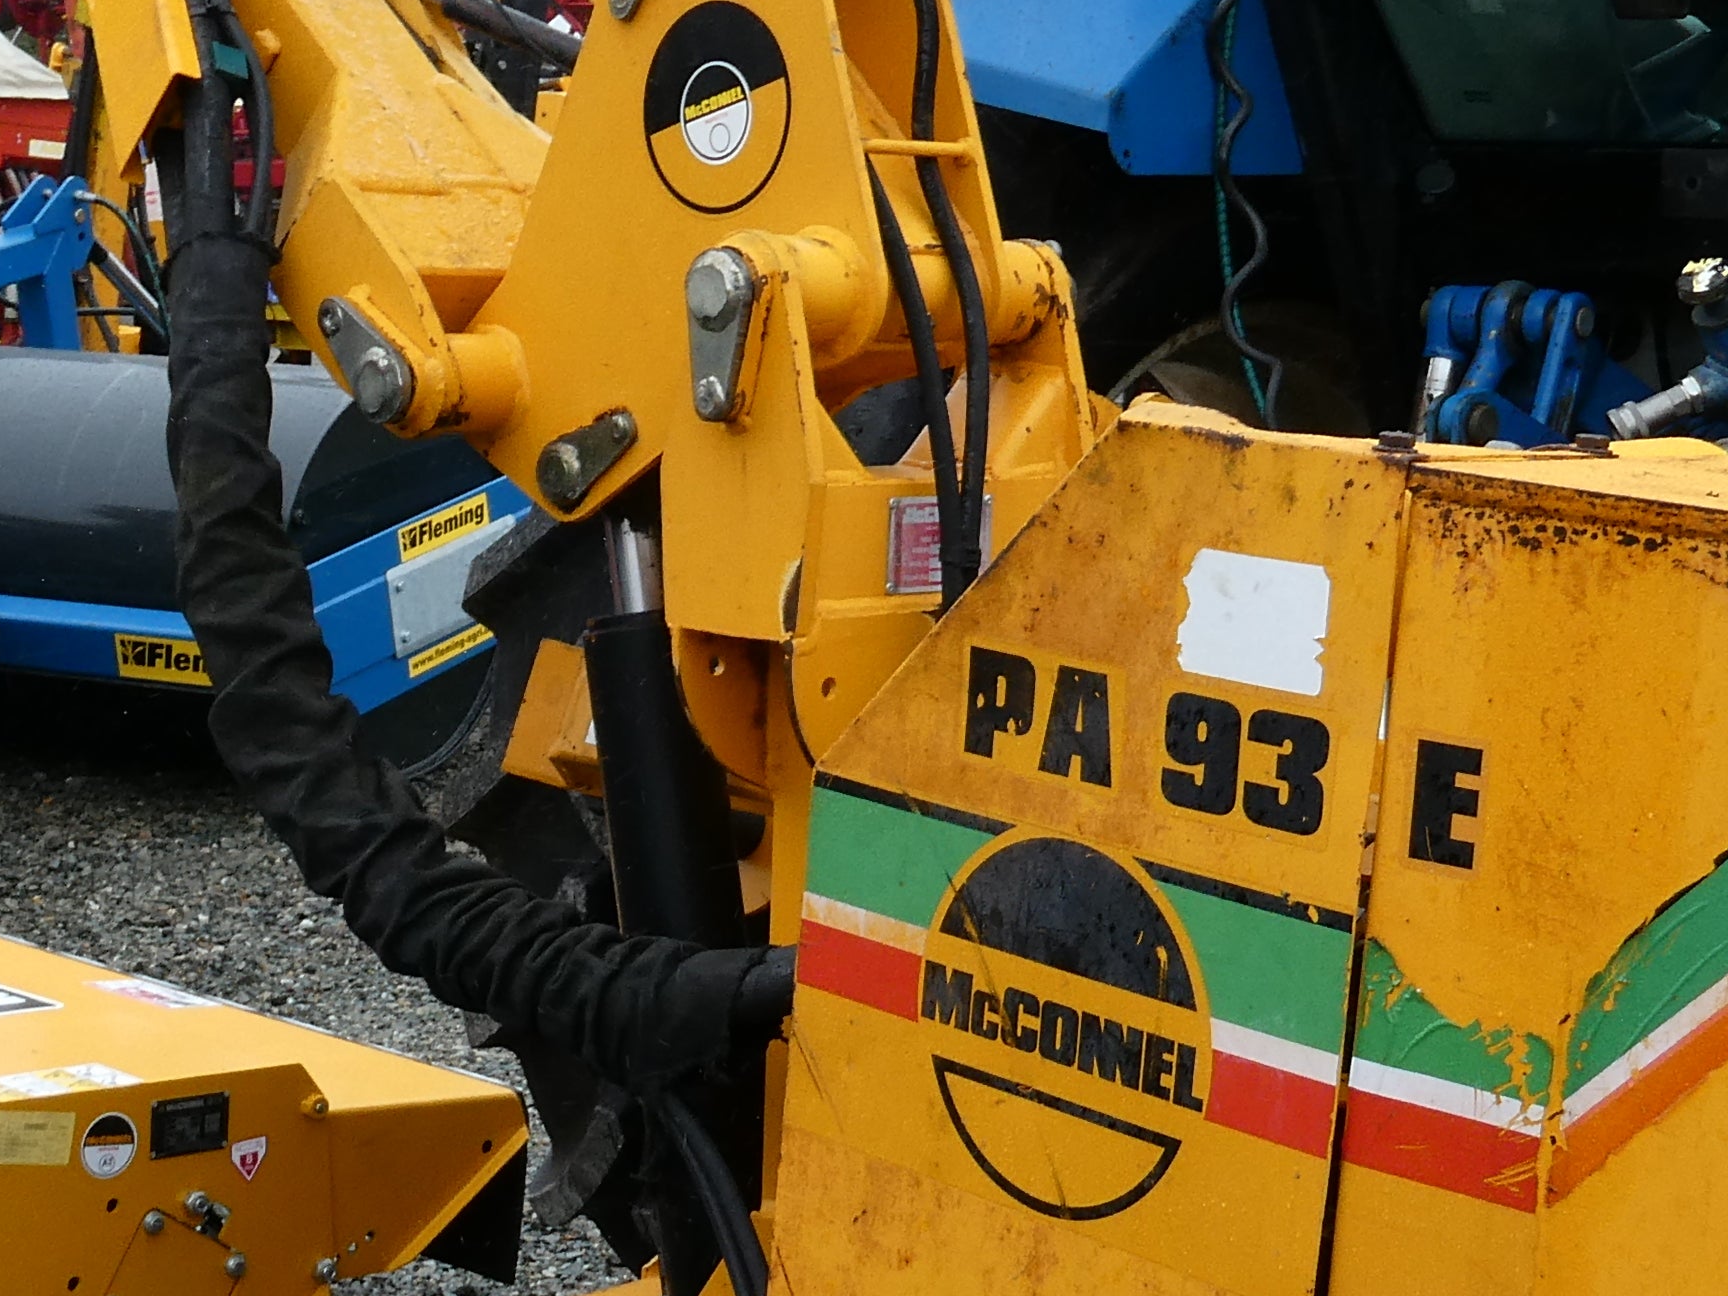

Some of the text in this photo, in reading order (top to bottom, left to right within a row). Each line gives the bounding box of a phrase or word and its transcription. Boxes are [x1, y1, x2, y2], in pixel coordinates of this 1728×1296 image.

[417, 501, 485, 546] Fleming
[963, 644, 1483, 870] PA 93 E
[922, 958, 1204, 1113] McCONNEL
